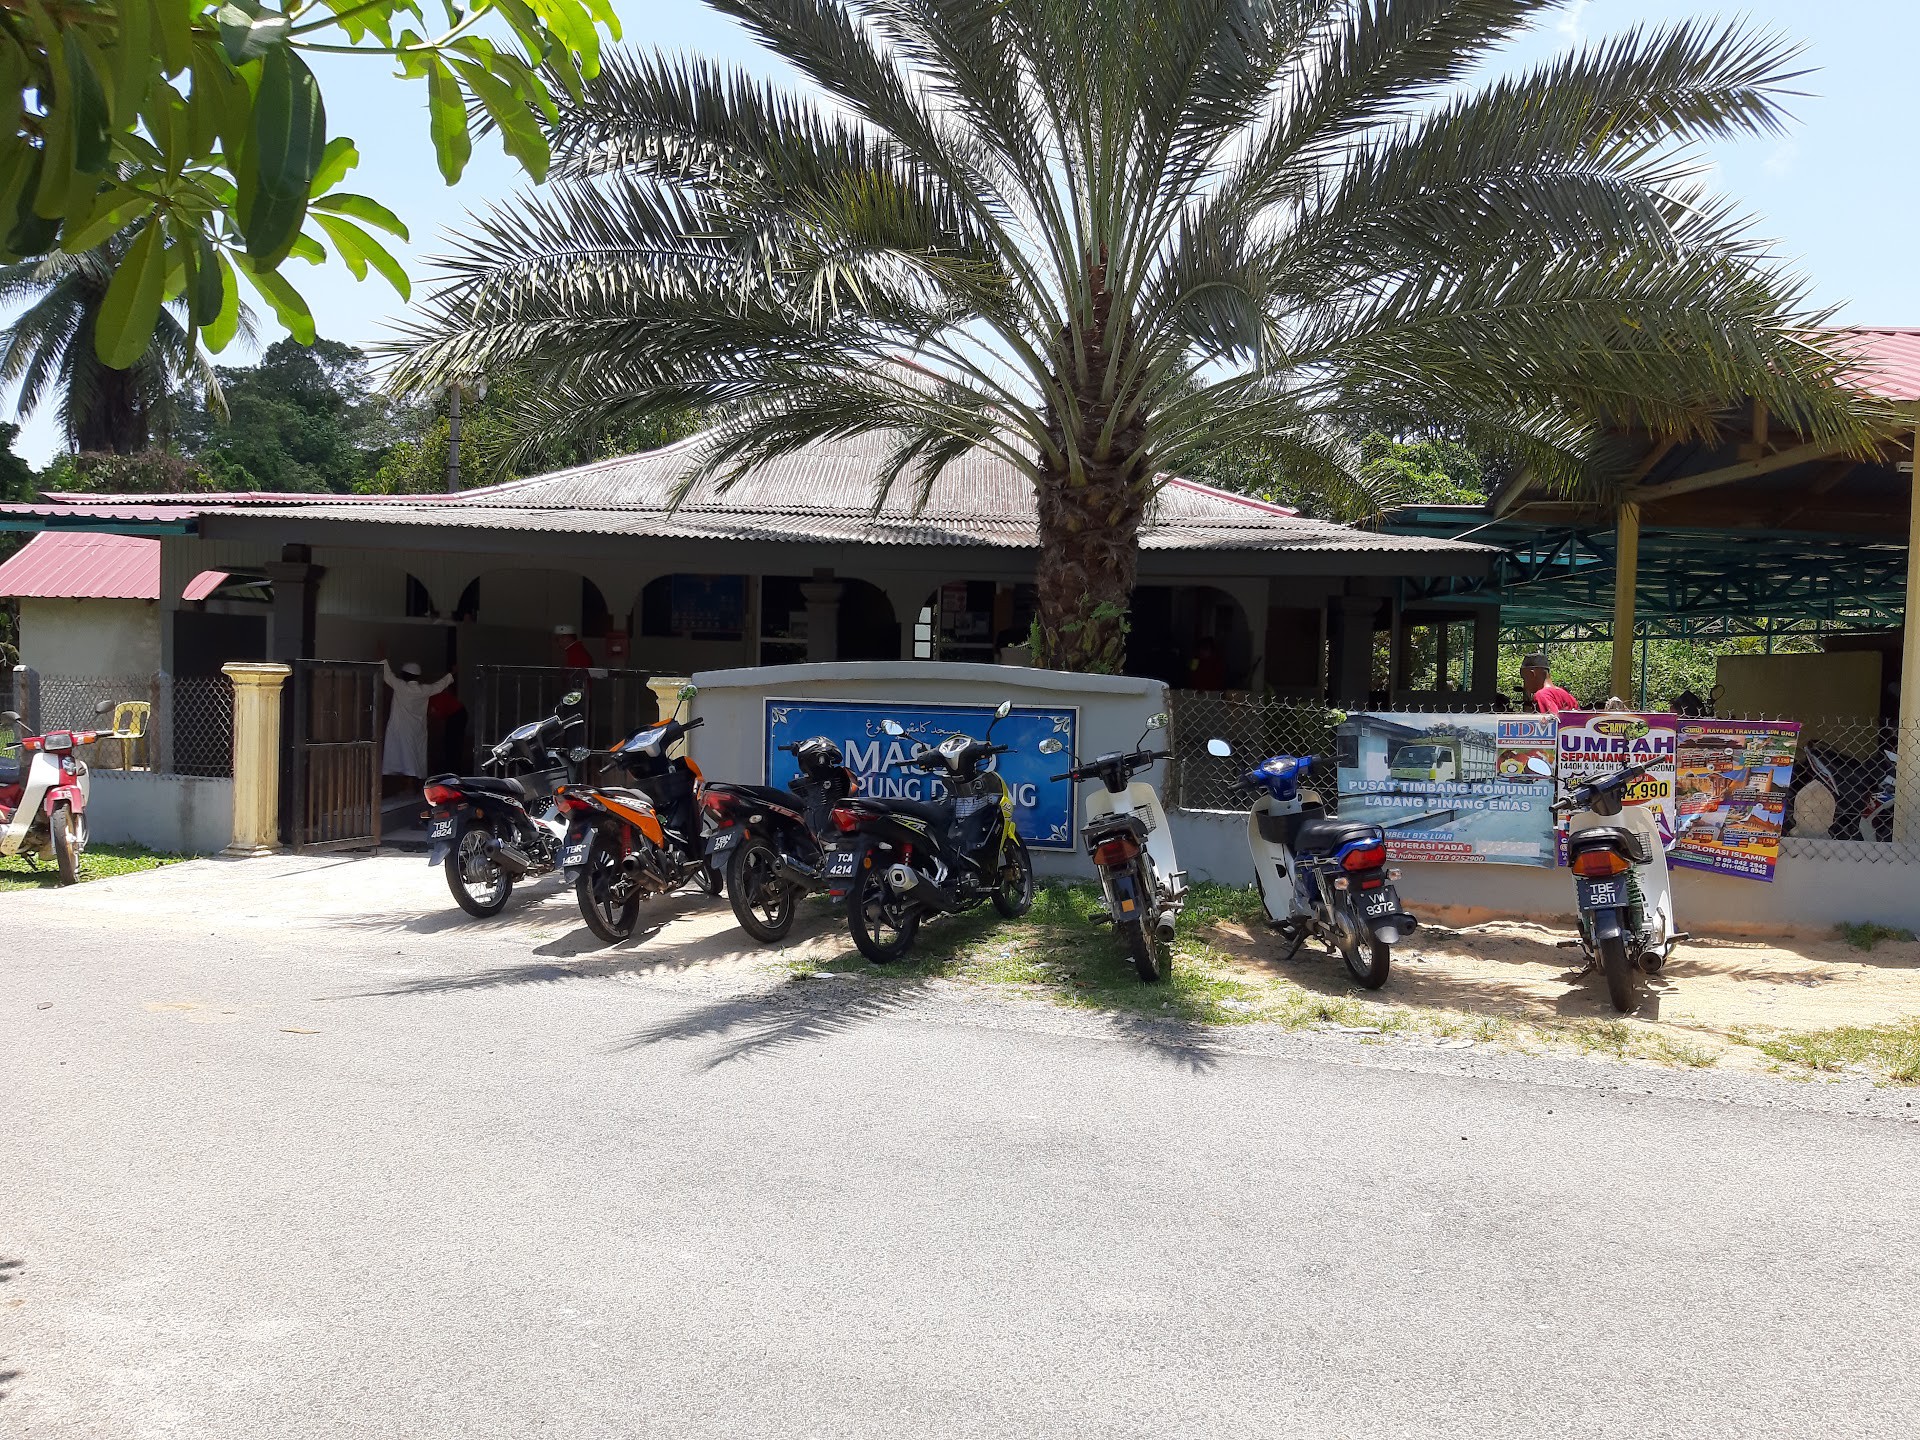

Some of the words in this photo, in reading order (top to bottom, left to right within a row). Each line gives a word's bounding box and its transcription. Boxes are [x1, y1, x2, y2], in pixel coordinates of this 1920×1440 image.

[1500, 721, 1554, 737] TDM
[1561, 735, 1674, 753] UMRAH
[1561, 753, 1630, 763] SEPANJANG
[1634, 754, 1673, 764] TAHN
[1349, 781, 1395, 791] PUSAT
[1401, 782, 1467, 793] TIMBANG
[1473, 784, 1548, 796] KOMUNITI
[1365, 796, 1424, 807] LADANG
[1428, 798, 1484, 809] PINANG
[1489, 800, 1530, 811] EMAS
[434, 821, 451, 830] TBU
[431, 828, 452, 838] 4824
[1412, 832, 1429, 840] BTS
[566, 845, 583, 854] TBR
[1438, 844, 1464, 852] PADA
[838, 853, 853, 862] TCA
[1398, 853, 1429, 862] hubungi
[1731, 850, 1767, 862] ISLAMIK
[830, 865, 853, 874] 4214
[1590, 882, 1615, 894] TBE
[1369, 893, 1385, 904] VW
[1591, 893, 1616, 904] 5611
[1366, 902, 1395, 915] 9372
